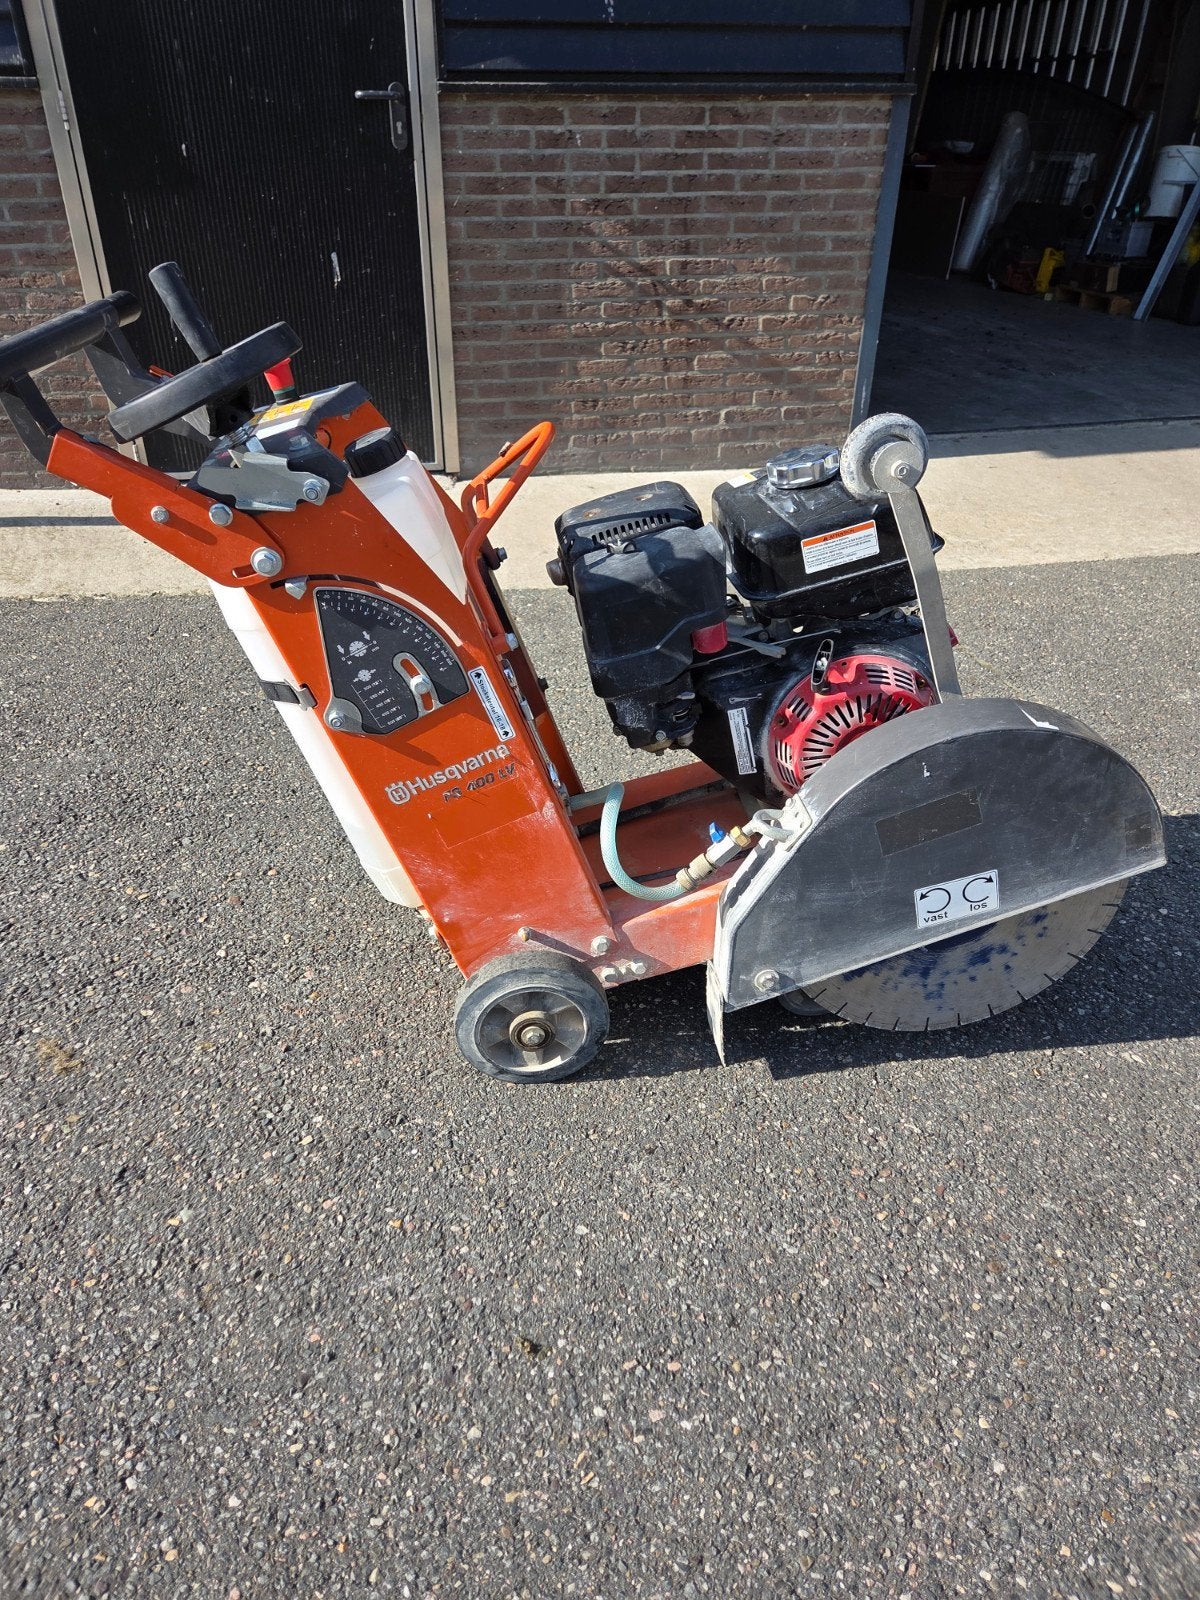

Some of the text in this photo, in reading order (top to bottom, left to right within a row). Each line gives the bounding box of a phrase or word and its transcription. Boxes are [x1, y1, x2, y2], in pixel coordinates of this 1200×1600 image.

[406, 744, 511, 796] Husqvarna
[467, 772, 495, 792] 400
[923, 902, 988, 923] vast los
